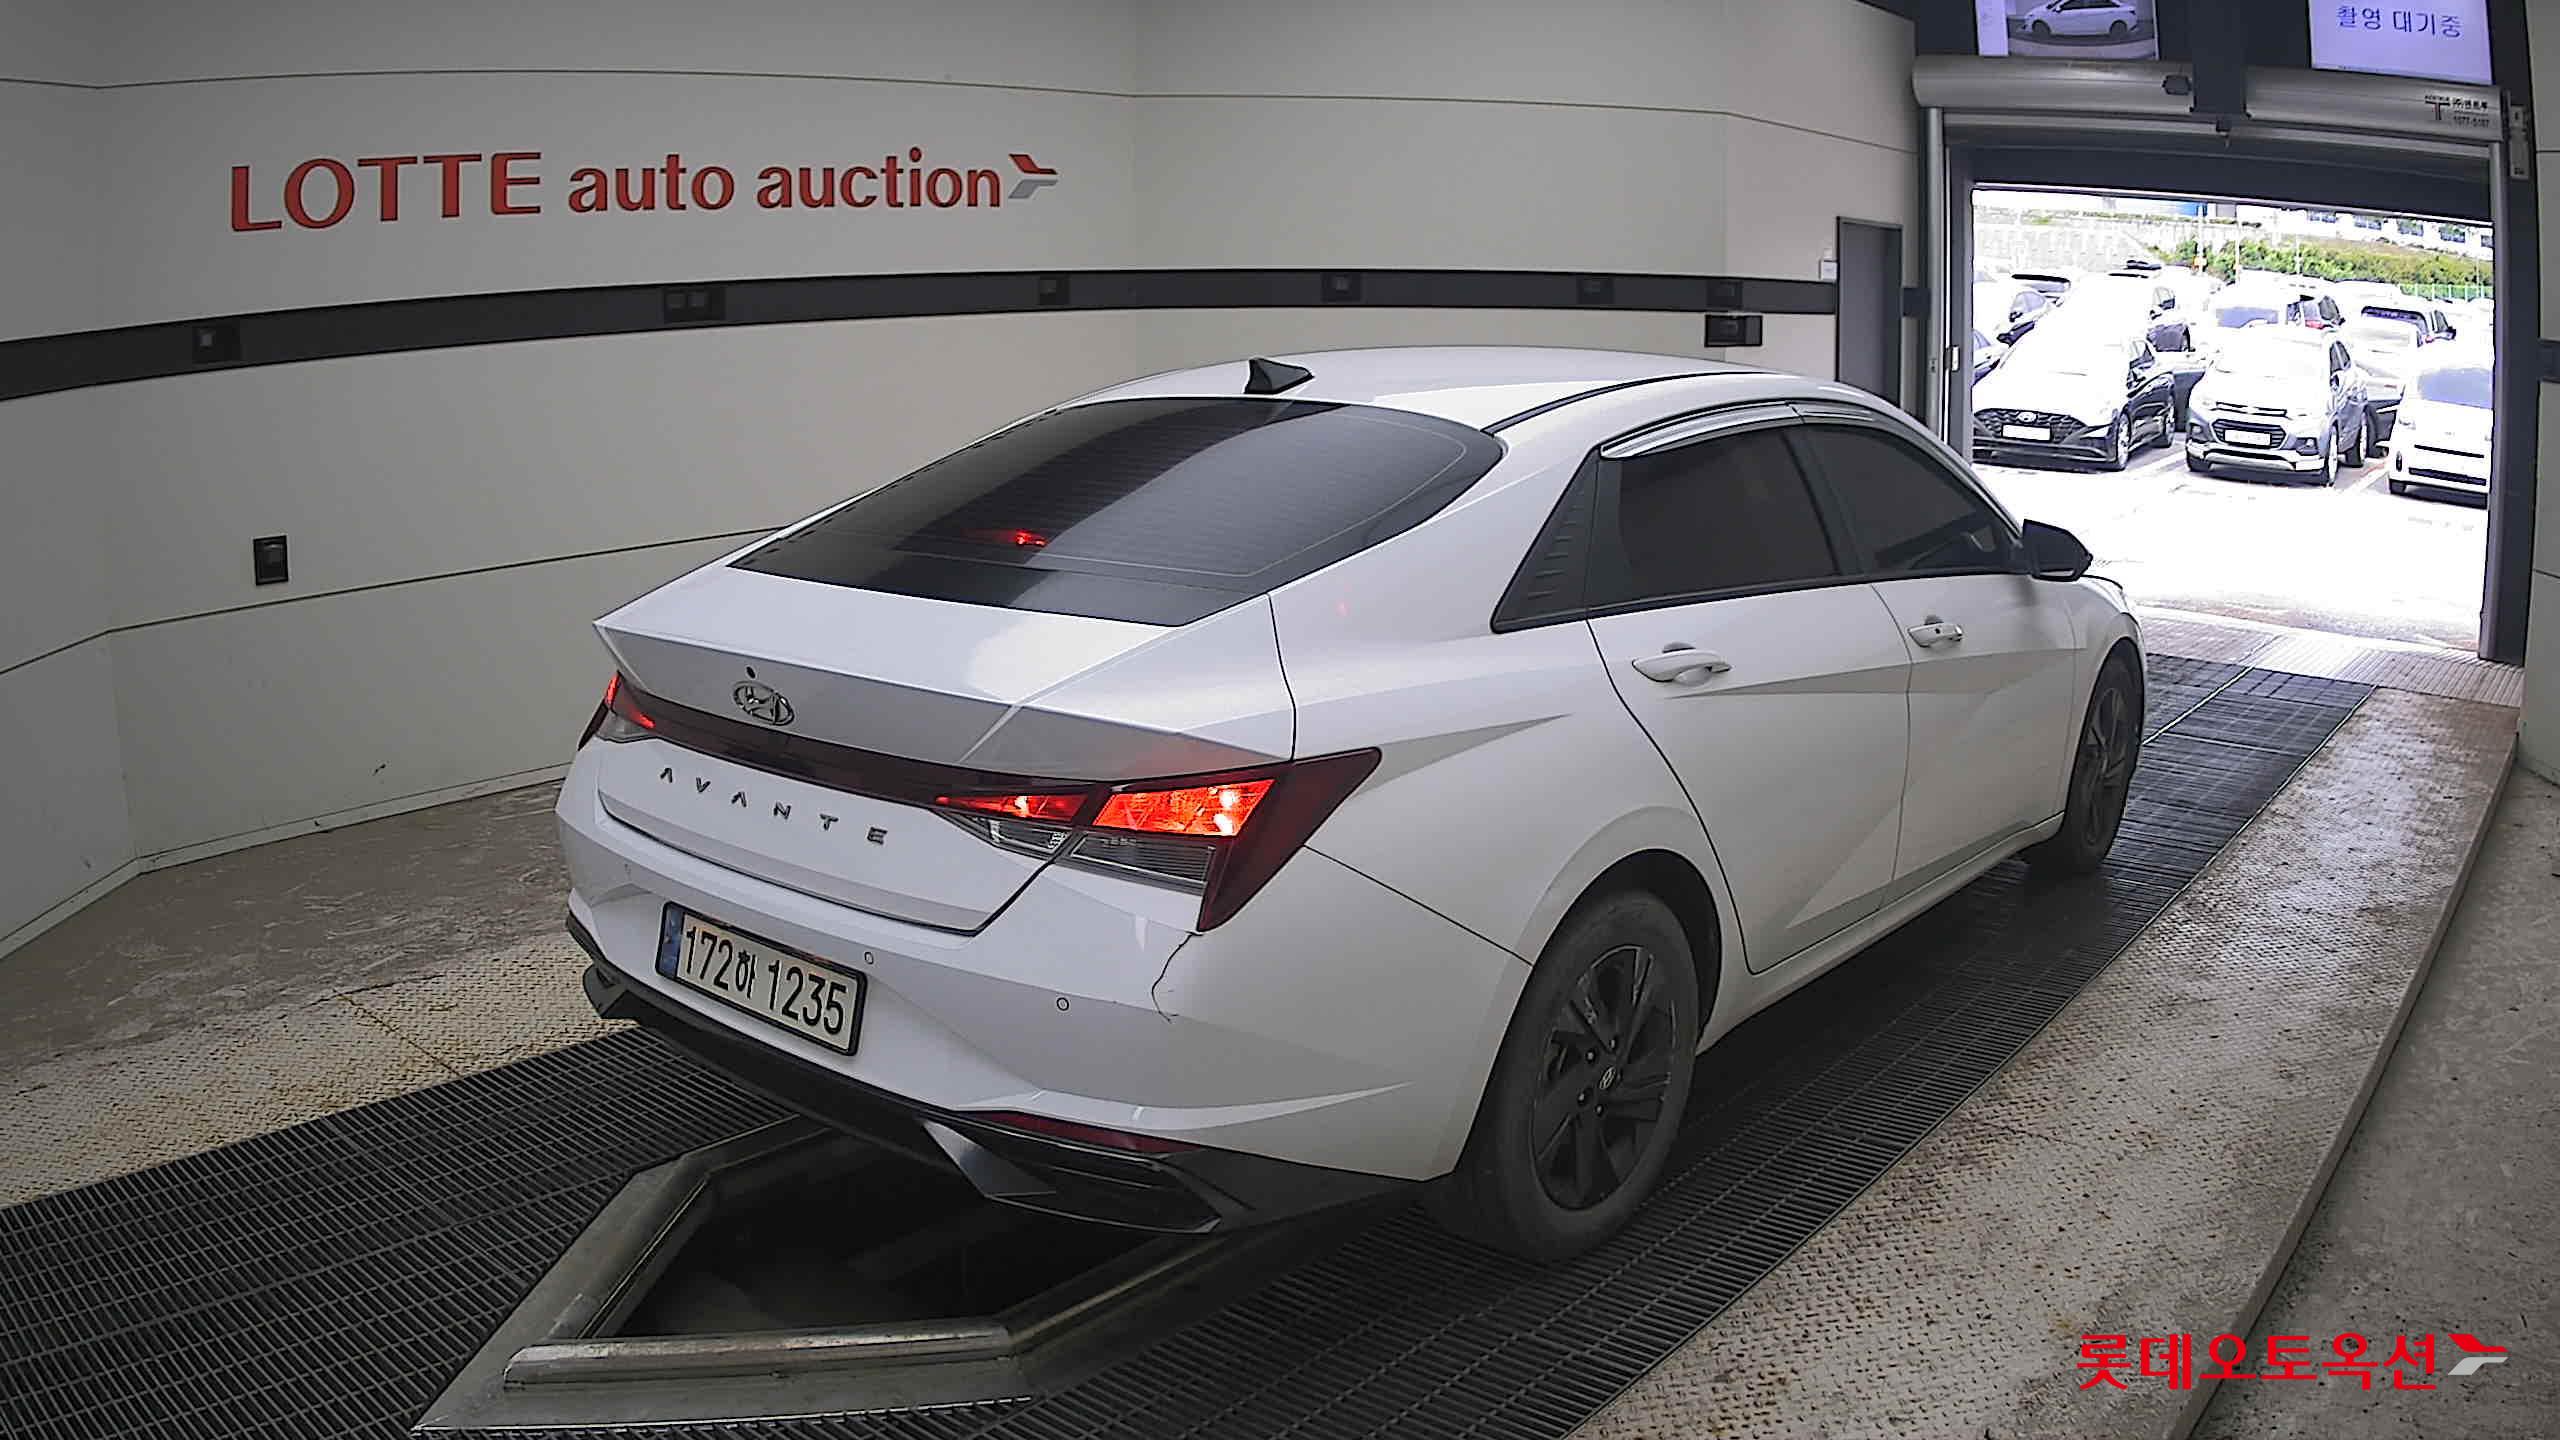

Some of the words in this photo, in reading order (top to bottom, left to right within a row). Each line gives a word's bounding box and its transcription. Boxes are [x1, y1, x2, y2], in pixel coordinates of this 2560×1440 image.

[2337, 5, 2381, 31] 촬영
[2392, 9, 2461, 39] 대기중
[231, 151, 542, 233] LOTTE
[567, 153, 736, 212] auto
[755, 146, 1001, 209] auction
[659, 766, 889, 847] AVANTE
[685, 925, 757, 1000] 172하
[767, 958, 848, 1036] 1235
